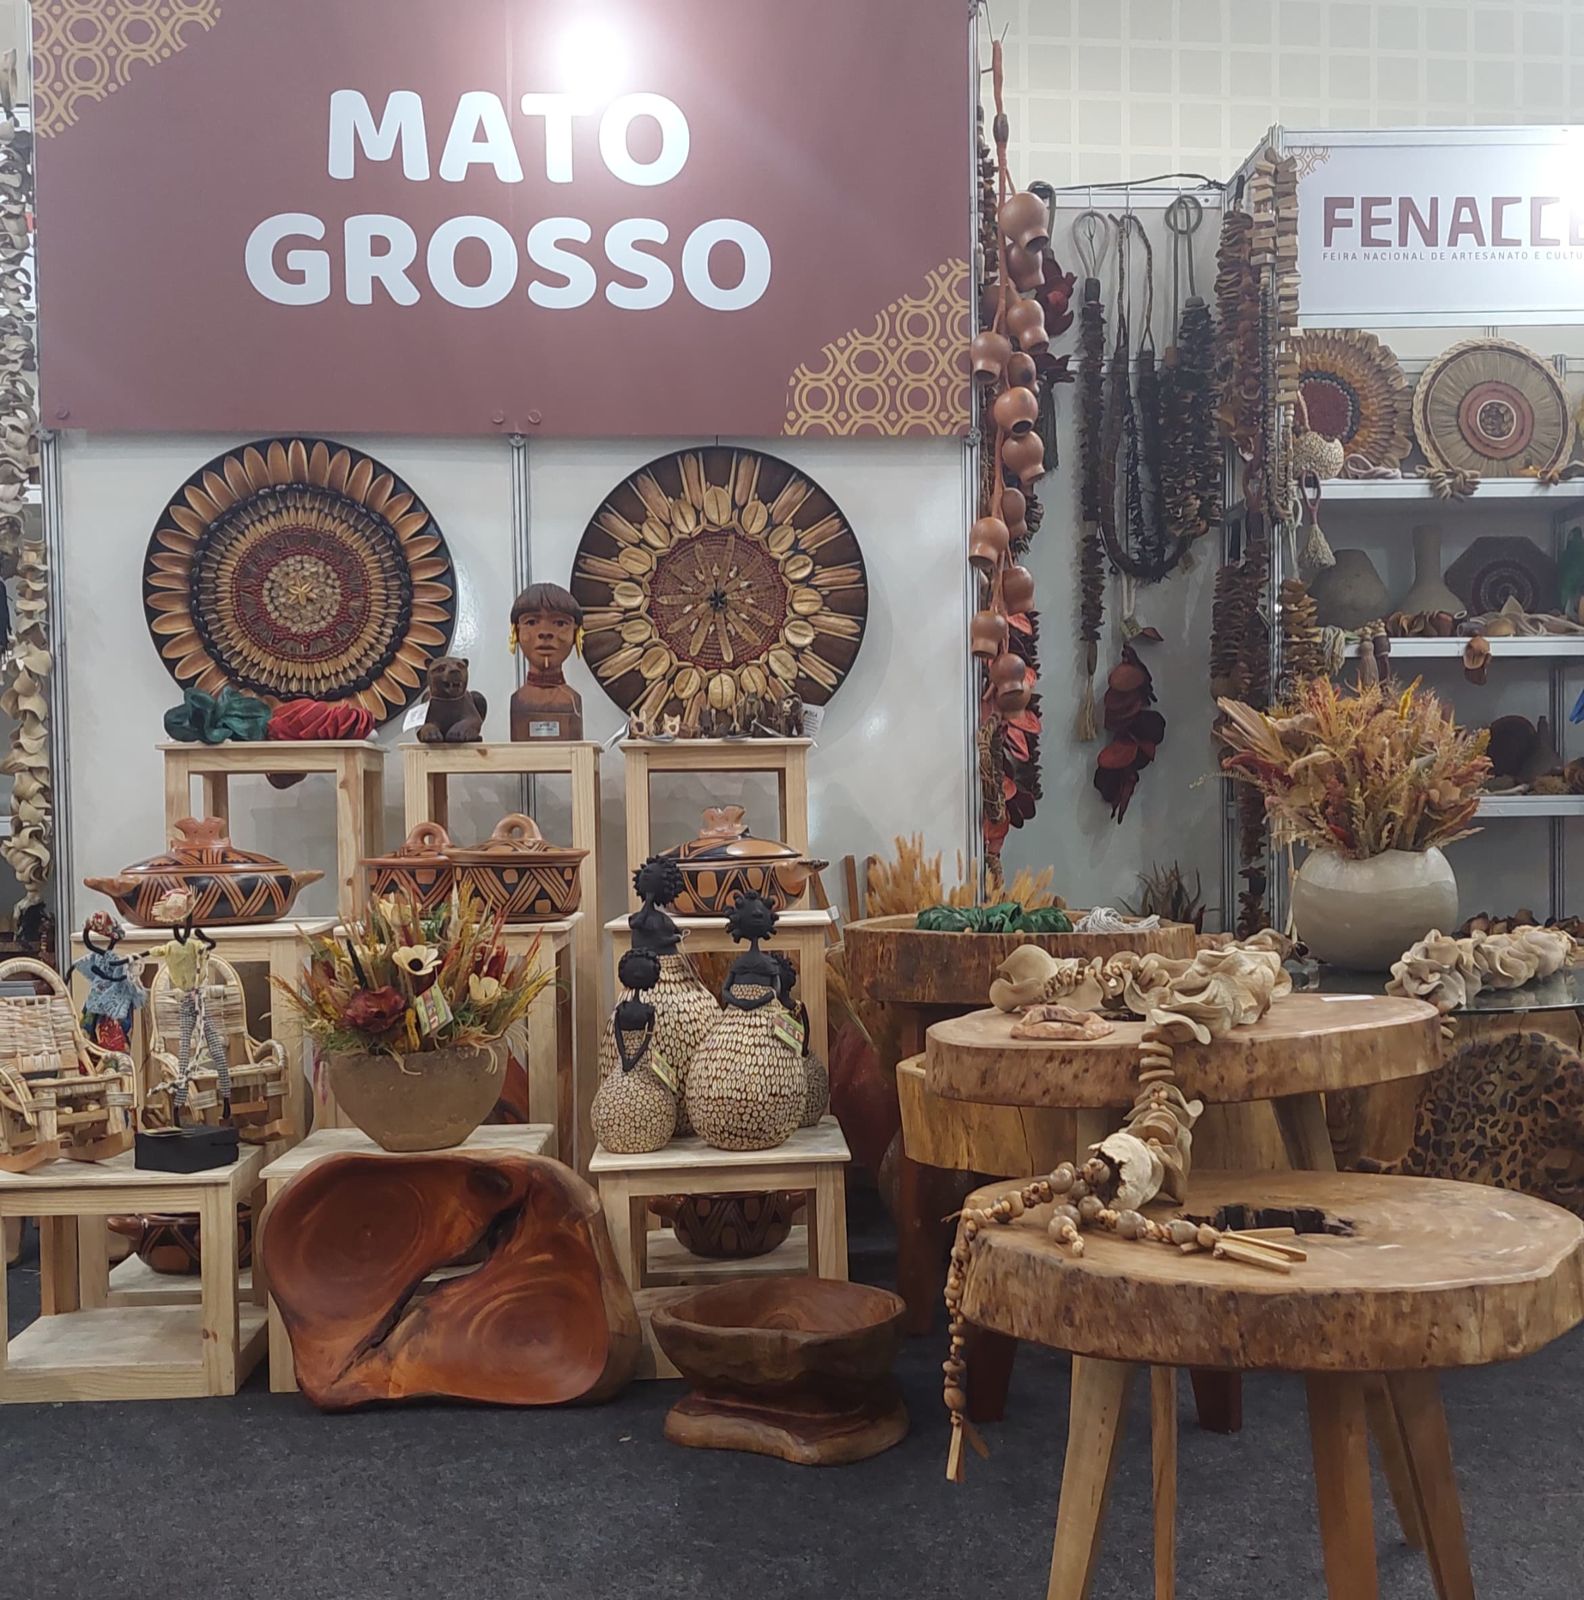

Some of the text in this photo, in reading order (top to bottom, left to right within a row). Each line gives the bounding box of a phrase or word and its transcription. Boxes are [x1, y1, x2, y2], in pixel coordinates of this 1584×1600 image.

[327, 89, 691, 187] MATO
[244, 212, 772, 311] GROSSO
[1322, 251, 1358, 261] FEIRA
[1363, 251, 1426, 261] NACIONAL
[1431, 251, 1446, 261] DE
[1451, 250, 1529, 261] ARTESANATO
[1534, 250, 1541, 261] E
